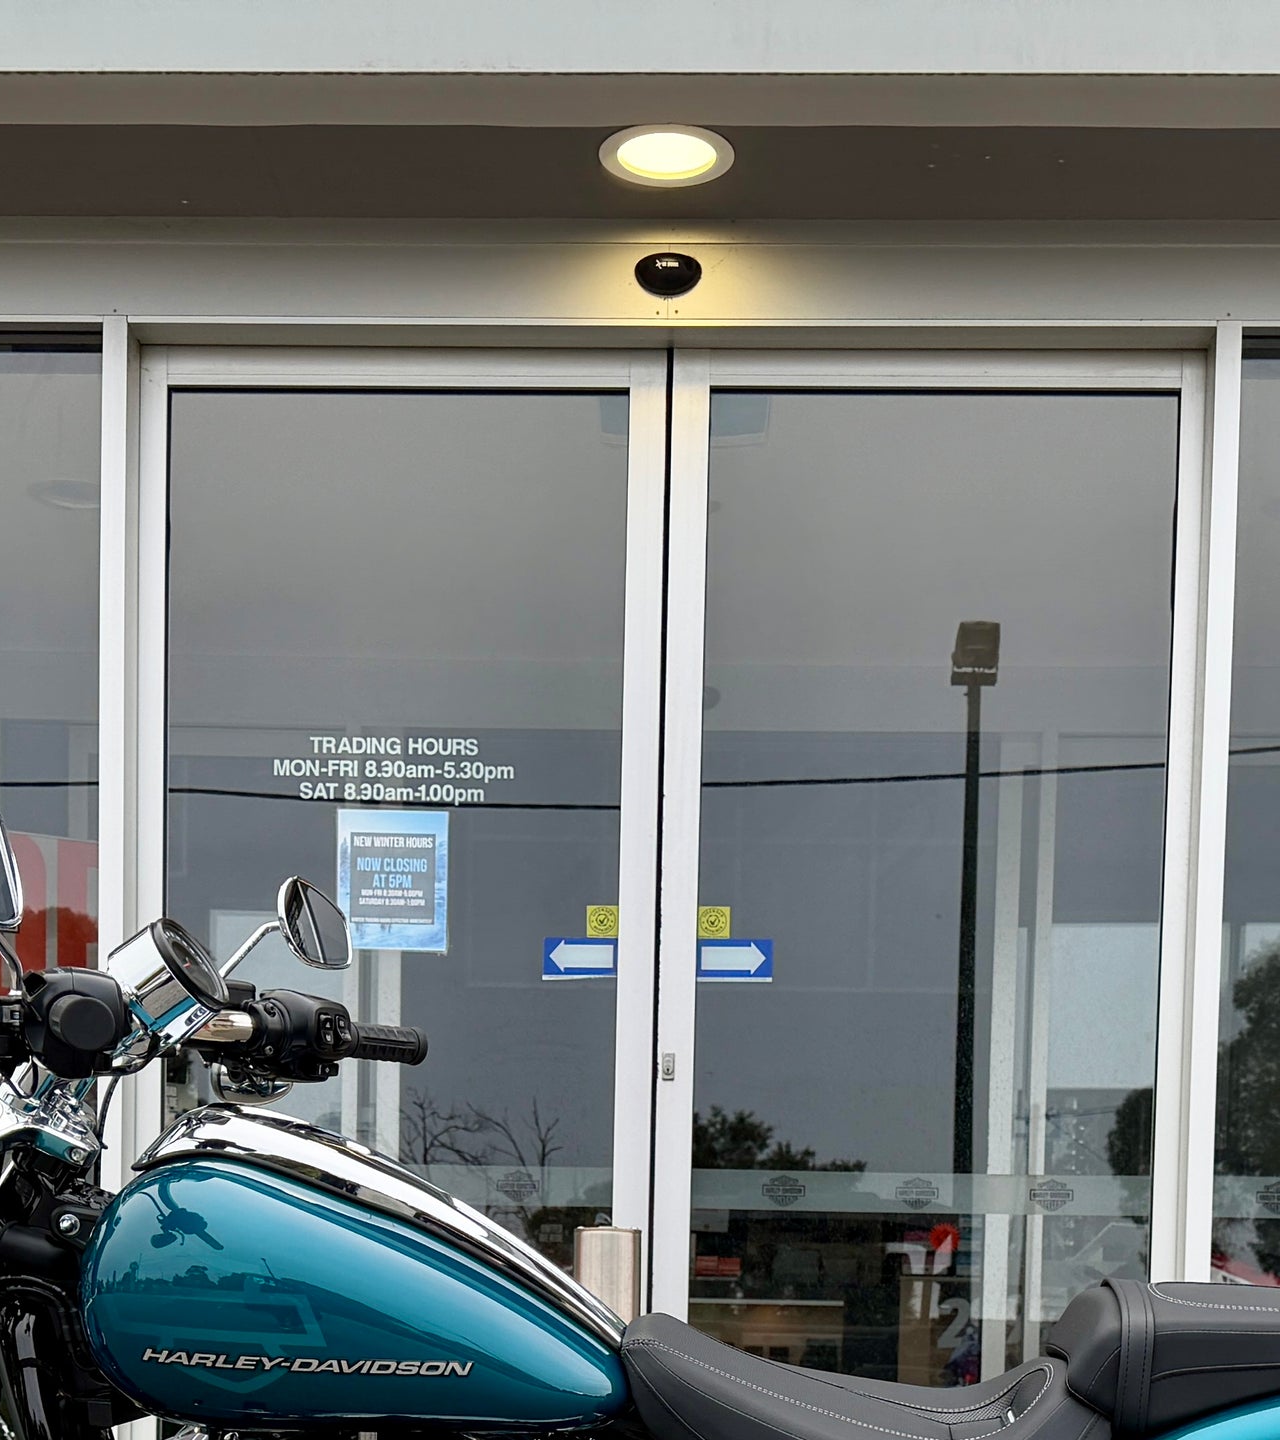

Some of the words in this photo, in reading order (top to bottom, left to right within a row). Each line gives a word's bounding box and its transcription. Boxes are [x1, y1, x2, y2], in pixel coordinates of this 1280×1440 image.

[310, 736, 401, 755] TRADING
[408, 738, 479, 756] HOURS
[273, 759, 358, 777] MON-FRI
[365, 761, 514, 783] 8.30am-5.30pm
[299, 782, 338, 800] SAT
[344, 783, 484, 806] 8.30am-1.00pm
[353, 836, 372, 847] NEW
[373, 836, 405, 848] WINTER
[406, 837, 433, 849] HOURS
[357, 857, 381, 871] NOW
[383, 858, 428, 872] CLOSING
[372, 874, 387, 888] AT
[388, 874, 412, 888] 5PM
[142, 1348, 475, 1377] HARLEY-DAVIDSON
